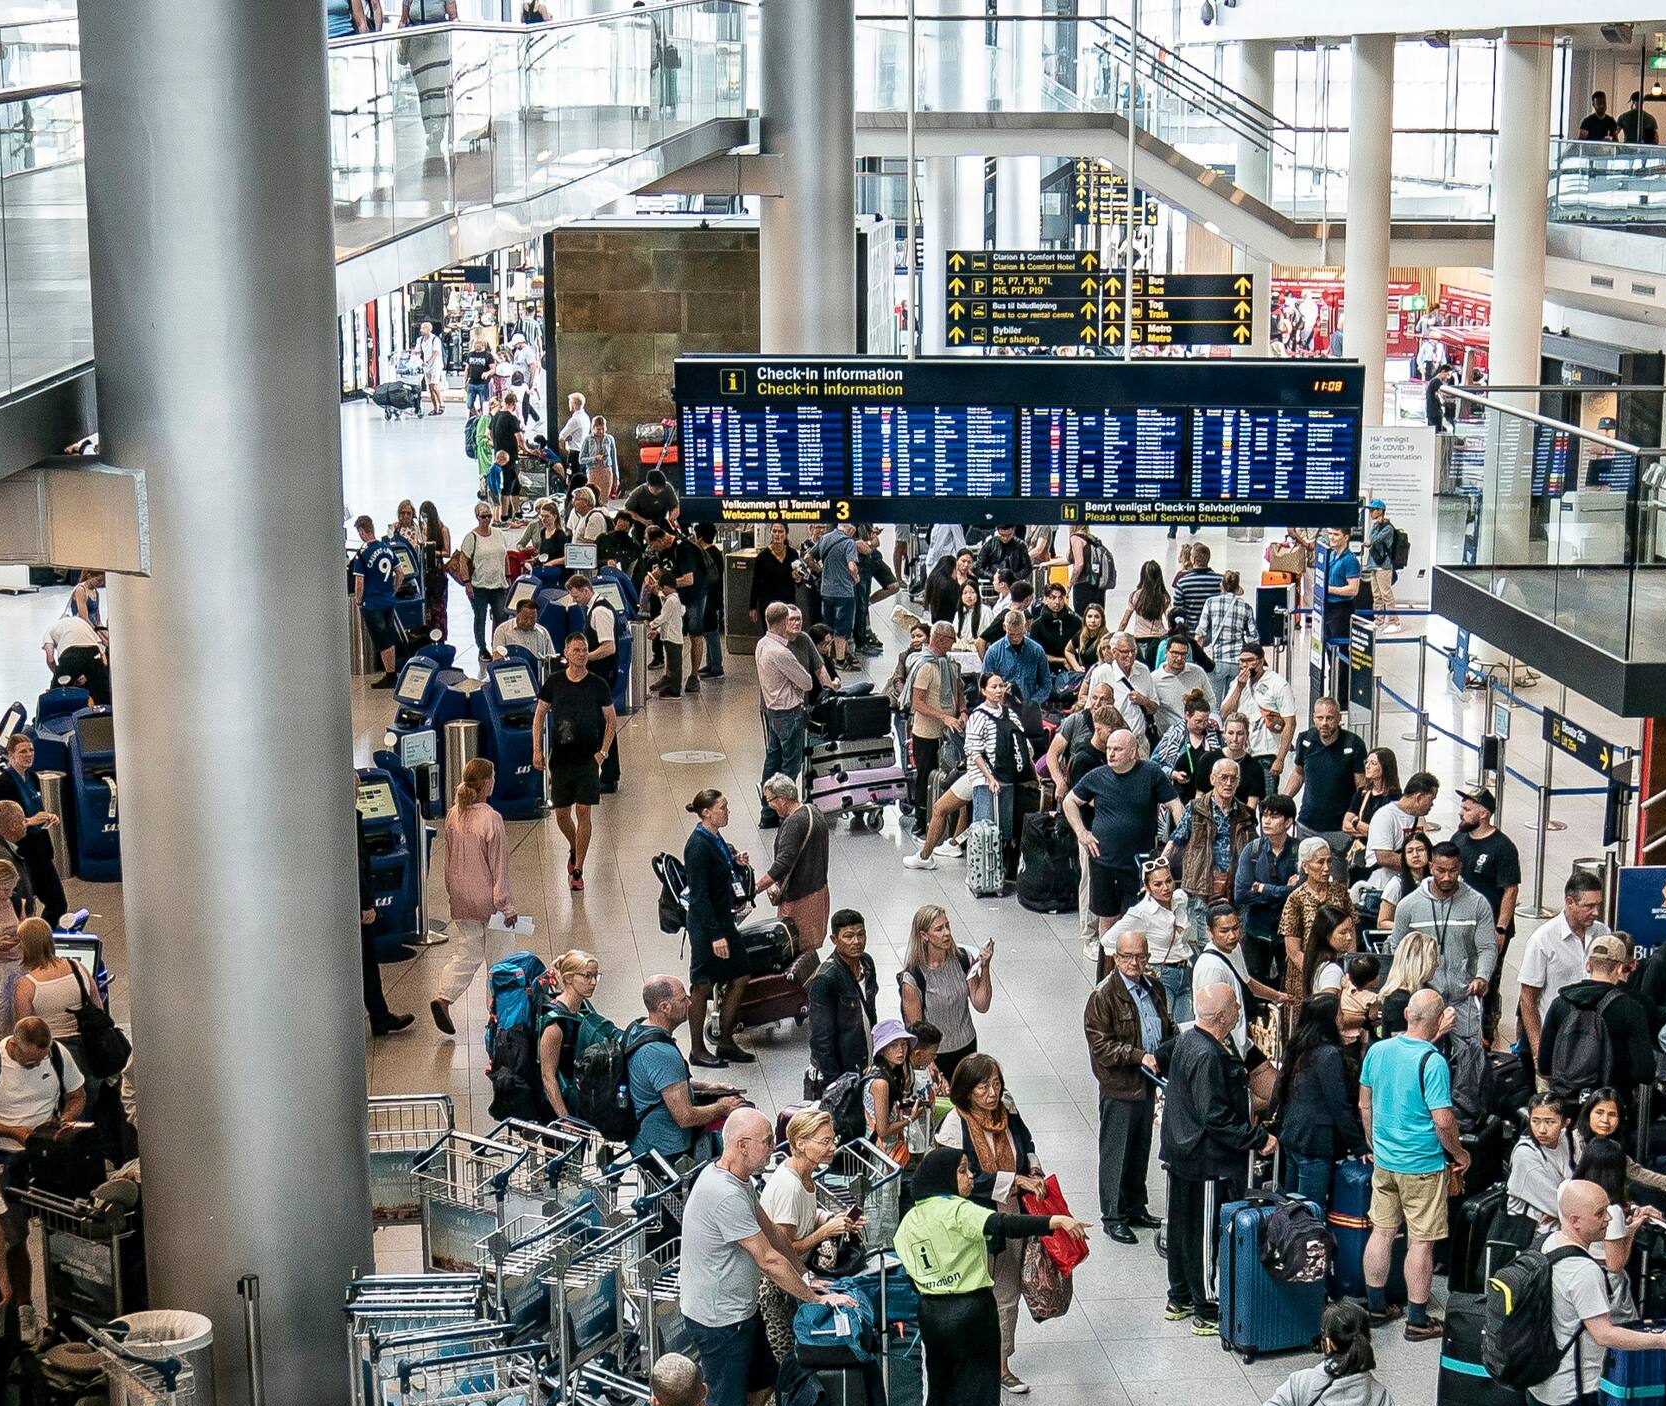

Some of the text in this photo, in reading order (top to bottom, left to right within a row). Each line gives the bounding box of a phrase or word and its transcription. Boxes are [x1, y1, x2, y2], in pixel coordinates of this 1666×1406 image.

[993, 253, 1075, 262] Clarion & Comfort Hotel
[993, 263, 1075, 271] Clarion & Comfort Hotel
[1149, 277, 1164, 285] Bus
[993, 302, 1005, 310] Bus
[1149, 302, 1163, 311] Tog
[993, 311, 1006, 319] Bus
[1027, 311, 1049, 319] rental
[993, 326, 1022, 337] Bybiler
[1149, 325, 1171, 333] Metro
[993, 335, 1040, 346] Car sharing
[1149, 334, 1171, 342] Metro
[756, 367, 904, 381] Check-in information
[756, 383, 904, 397] Check-in information
[1314, 380, 1343, 392] 11:08
[1383, 435, 1410, 444] venligst
[1369, 453, 1423, 461] dokumentation
[722, 500, 831, 510] Velkommen til Terminal
[1085, 502, 1262, 515] Benyt venligst Check-in Selvbetjening
[722, 510, 821, 520] Welcome to Terminal
[836, 501, 850, 520] 3
[1085, 512, 1240, 524] Please use Self Service Check-in
[378, 557, 392, 582] 9
[514, 764, 532, 775] SAS
[101, 823, 120, 833] SA
